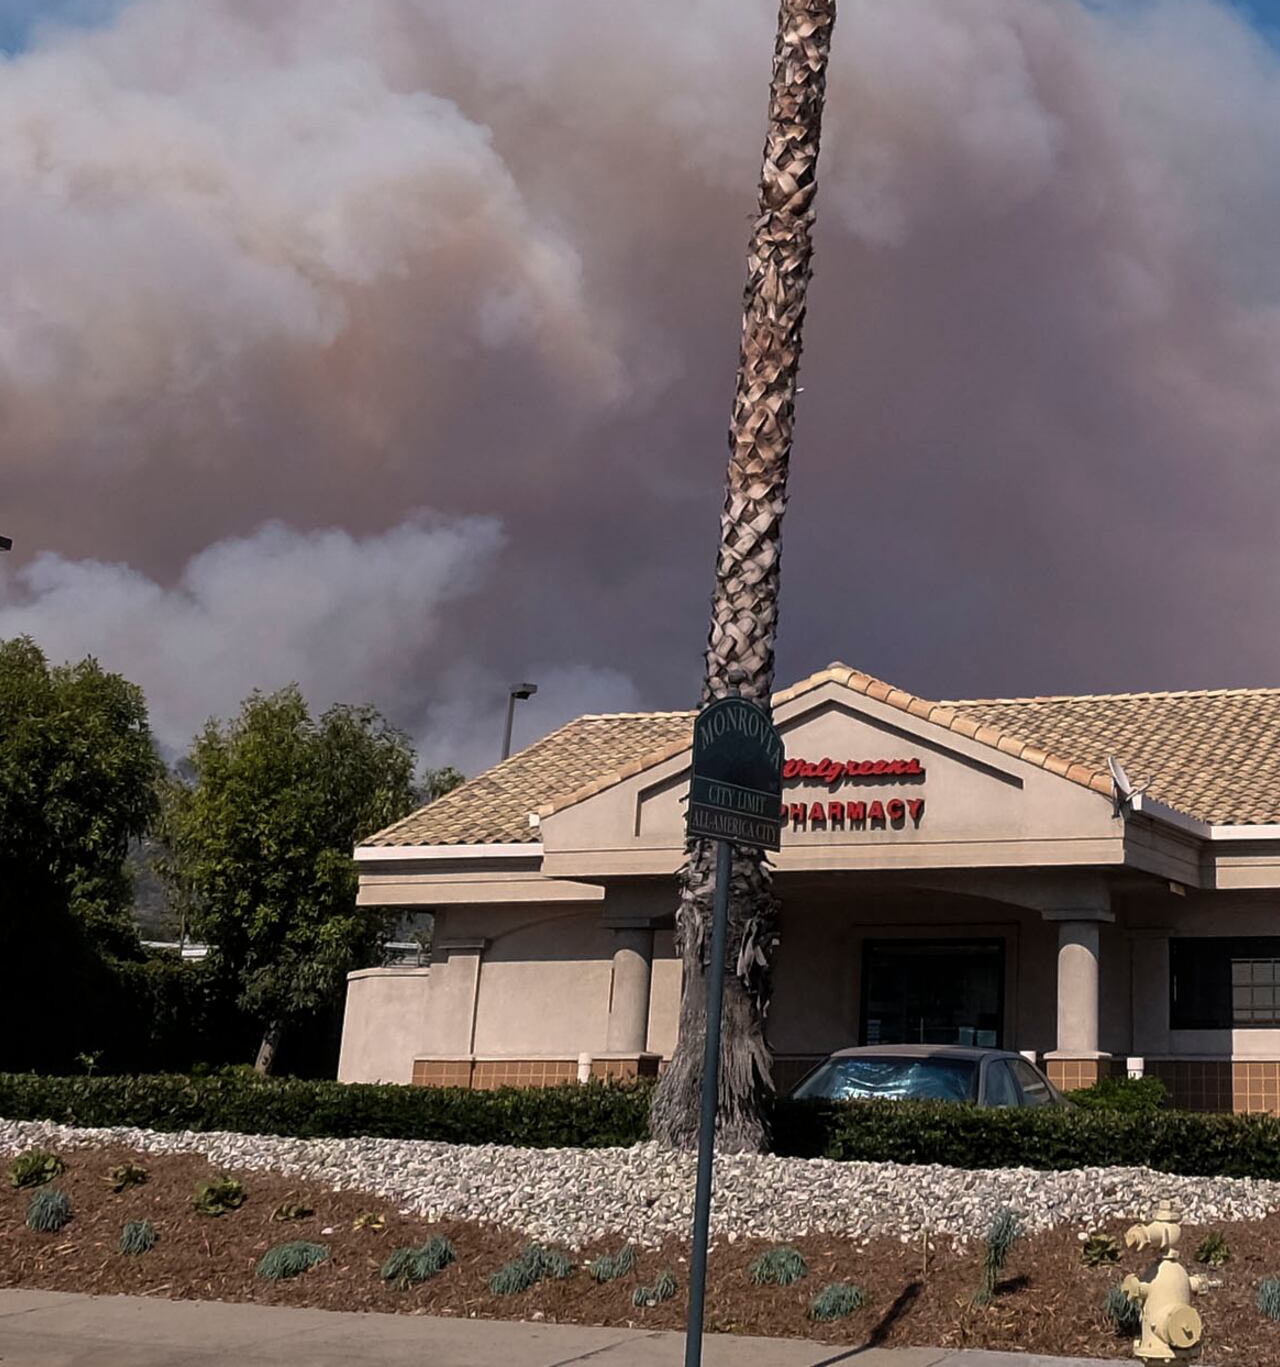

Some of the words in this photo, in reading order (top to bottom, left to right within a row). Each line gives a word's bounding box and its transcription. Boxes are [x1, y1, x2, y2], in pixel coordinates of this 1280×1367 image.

[701, 707, 781, 770] MONROVIA
[708, 785, 734, 807] CITY
[737, 792, 767, 814] LIMIT
[692, 811, 754, 838] ALL-AMERICA
[756, 823, 778, 843] CITY
